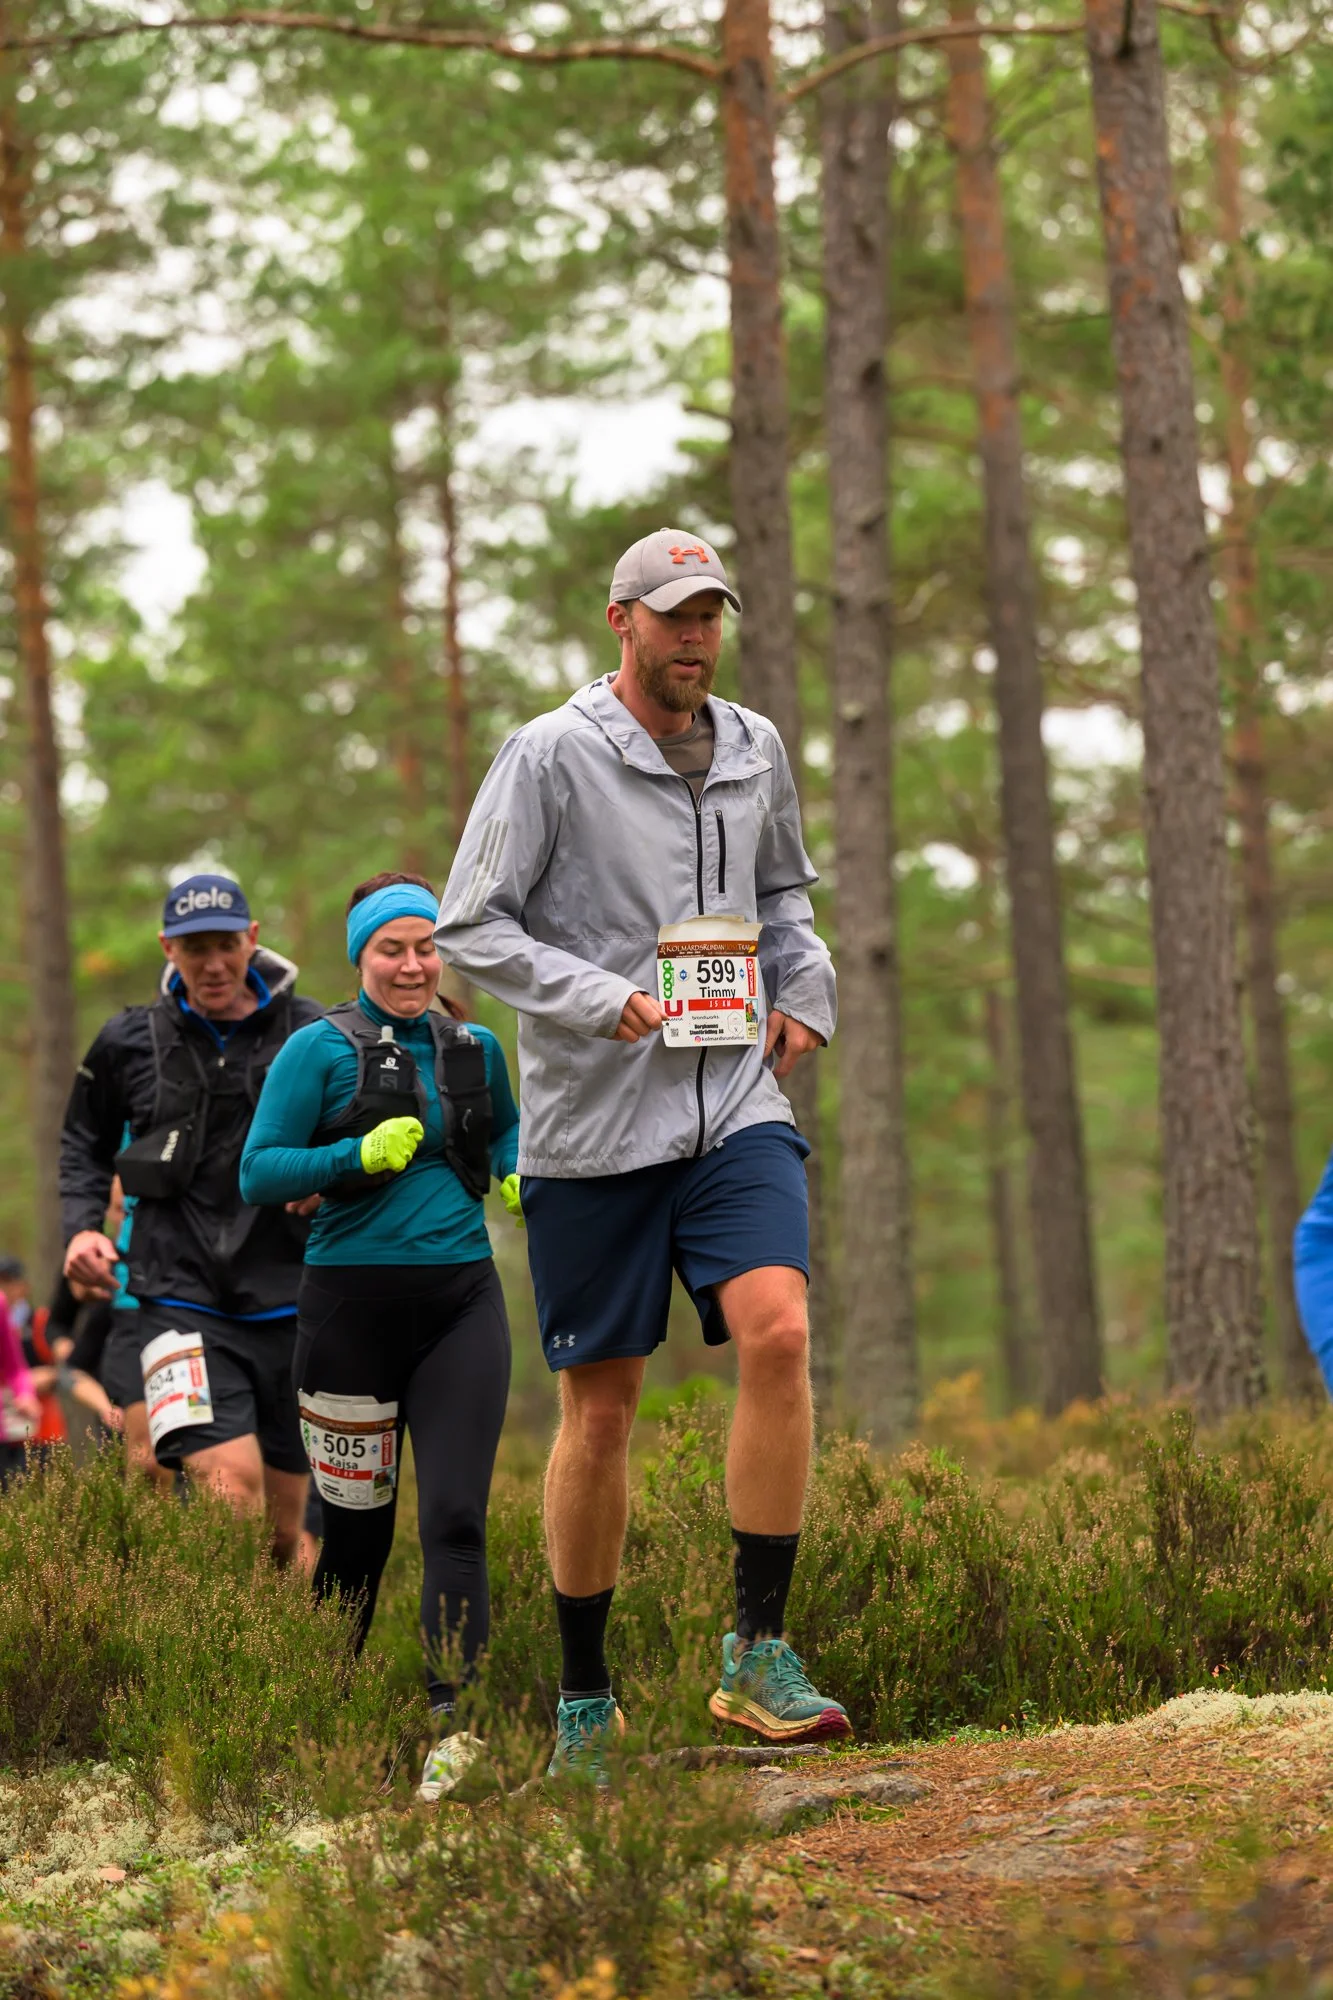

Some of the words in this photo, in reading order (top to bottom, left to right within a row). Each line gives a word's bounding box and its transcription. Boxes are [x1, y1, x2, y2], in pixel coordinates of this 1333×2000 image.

[175, 886, 233, 916] ciele
[663, 960, 674, 999] coop
[697, 959, 735, 983] 599
[699, 987, 736, 1000] Timmy
[323, 1433, 366, 1458] 505
[328, 1456, 358, 1470] Kajsa
